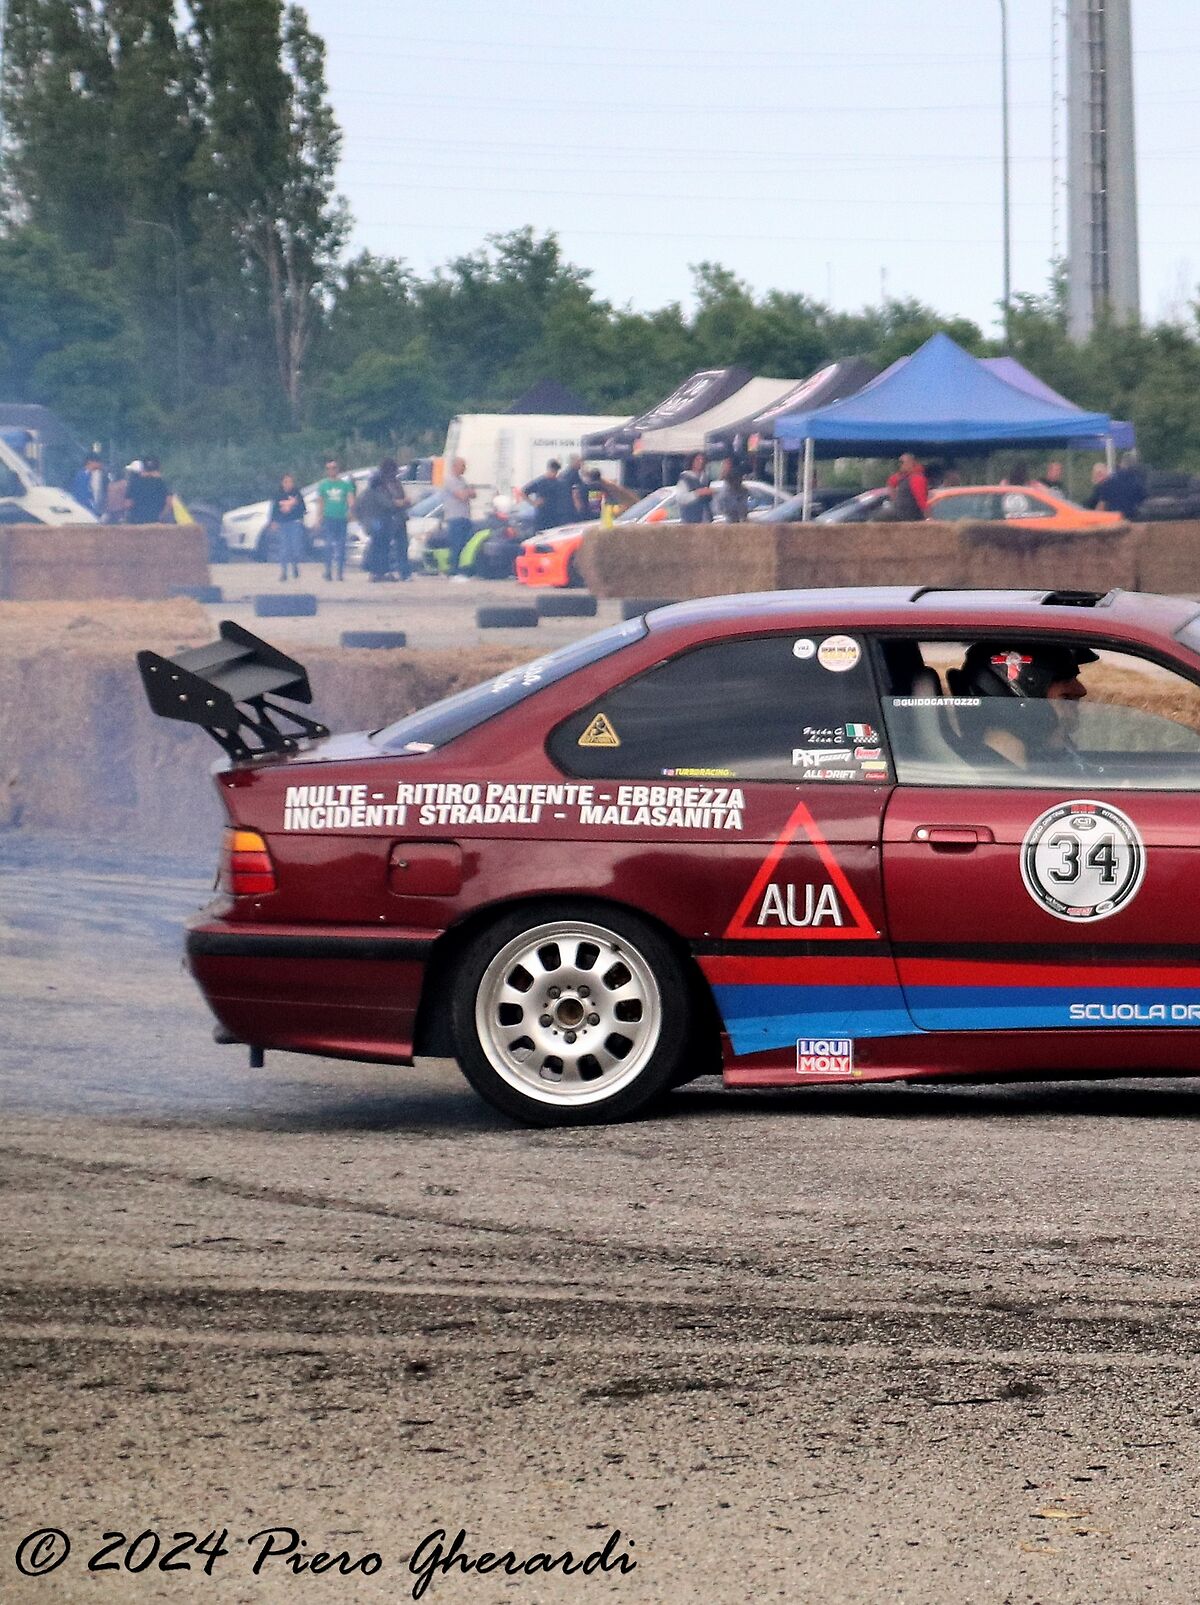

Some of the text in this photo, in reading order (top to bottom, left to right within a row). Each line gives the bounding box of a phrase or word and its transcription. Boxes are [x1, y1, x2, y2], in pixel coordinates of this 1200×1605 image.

[285, 785, 368, 807] MULTE
[397, 784, 481, 805] RITIRO
[485, 784, 594, 805] PATENTE
[617, 785, 745, 809] EBBREZZA
[284, 805, 406, 830] INCIDENTI
[419, 804, 542, 825] STRADALI
[579, 805, 744, 830] MALASANITÀ
[1047, 832, 1119, 885] 34
[757, 883, 843, 926] AUA
[1069, 1004, 1165, 1020] SCUOLA
[800, 1040, 848, 1055] LIQUI
[800, 1056, 849, 1070] MOLY
